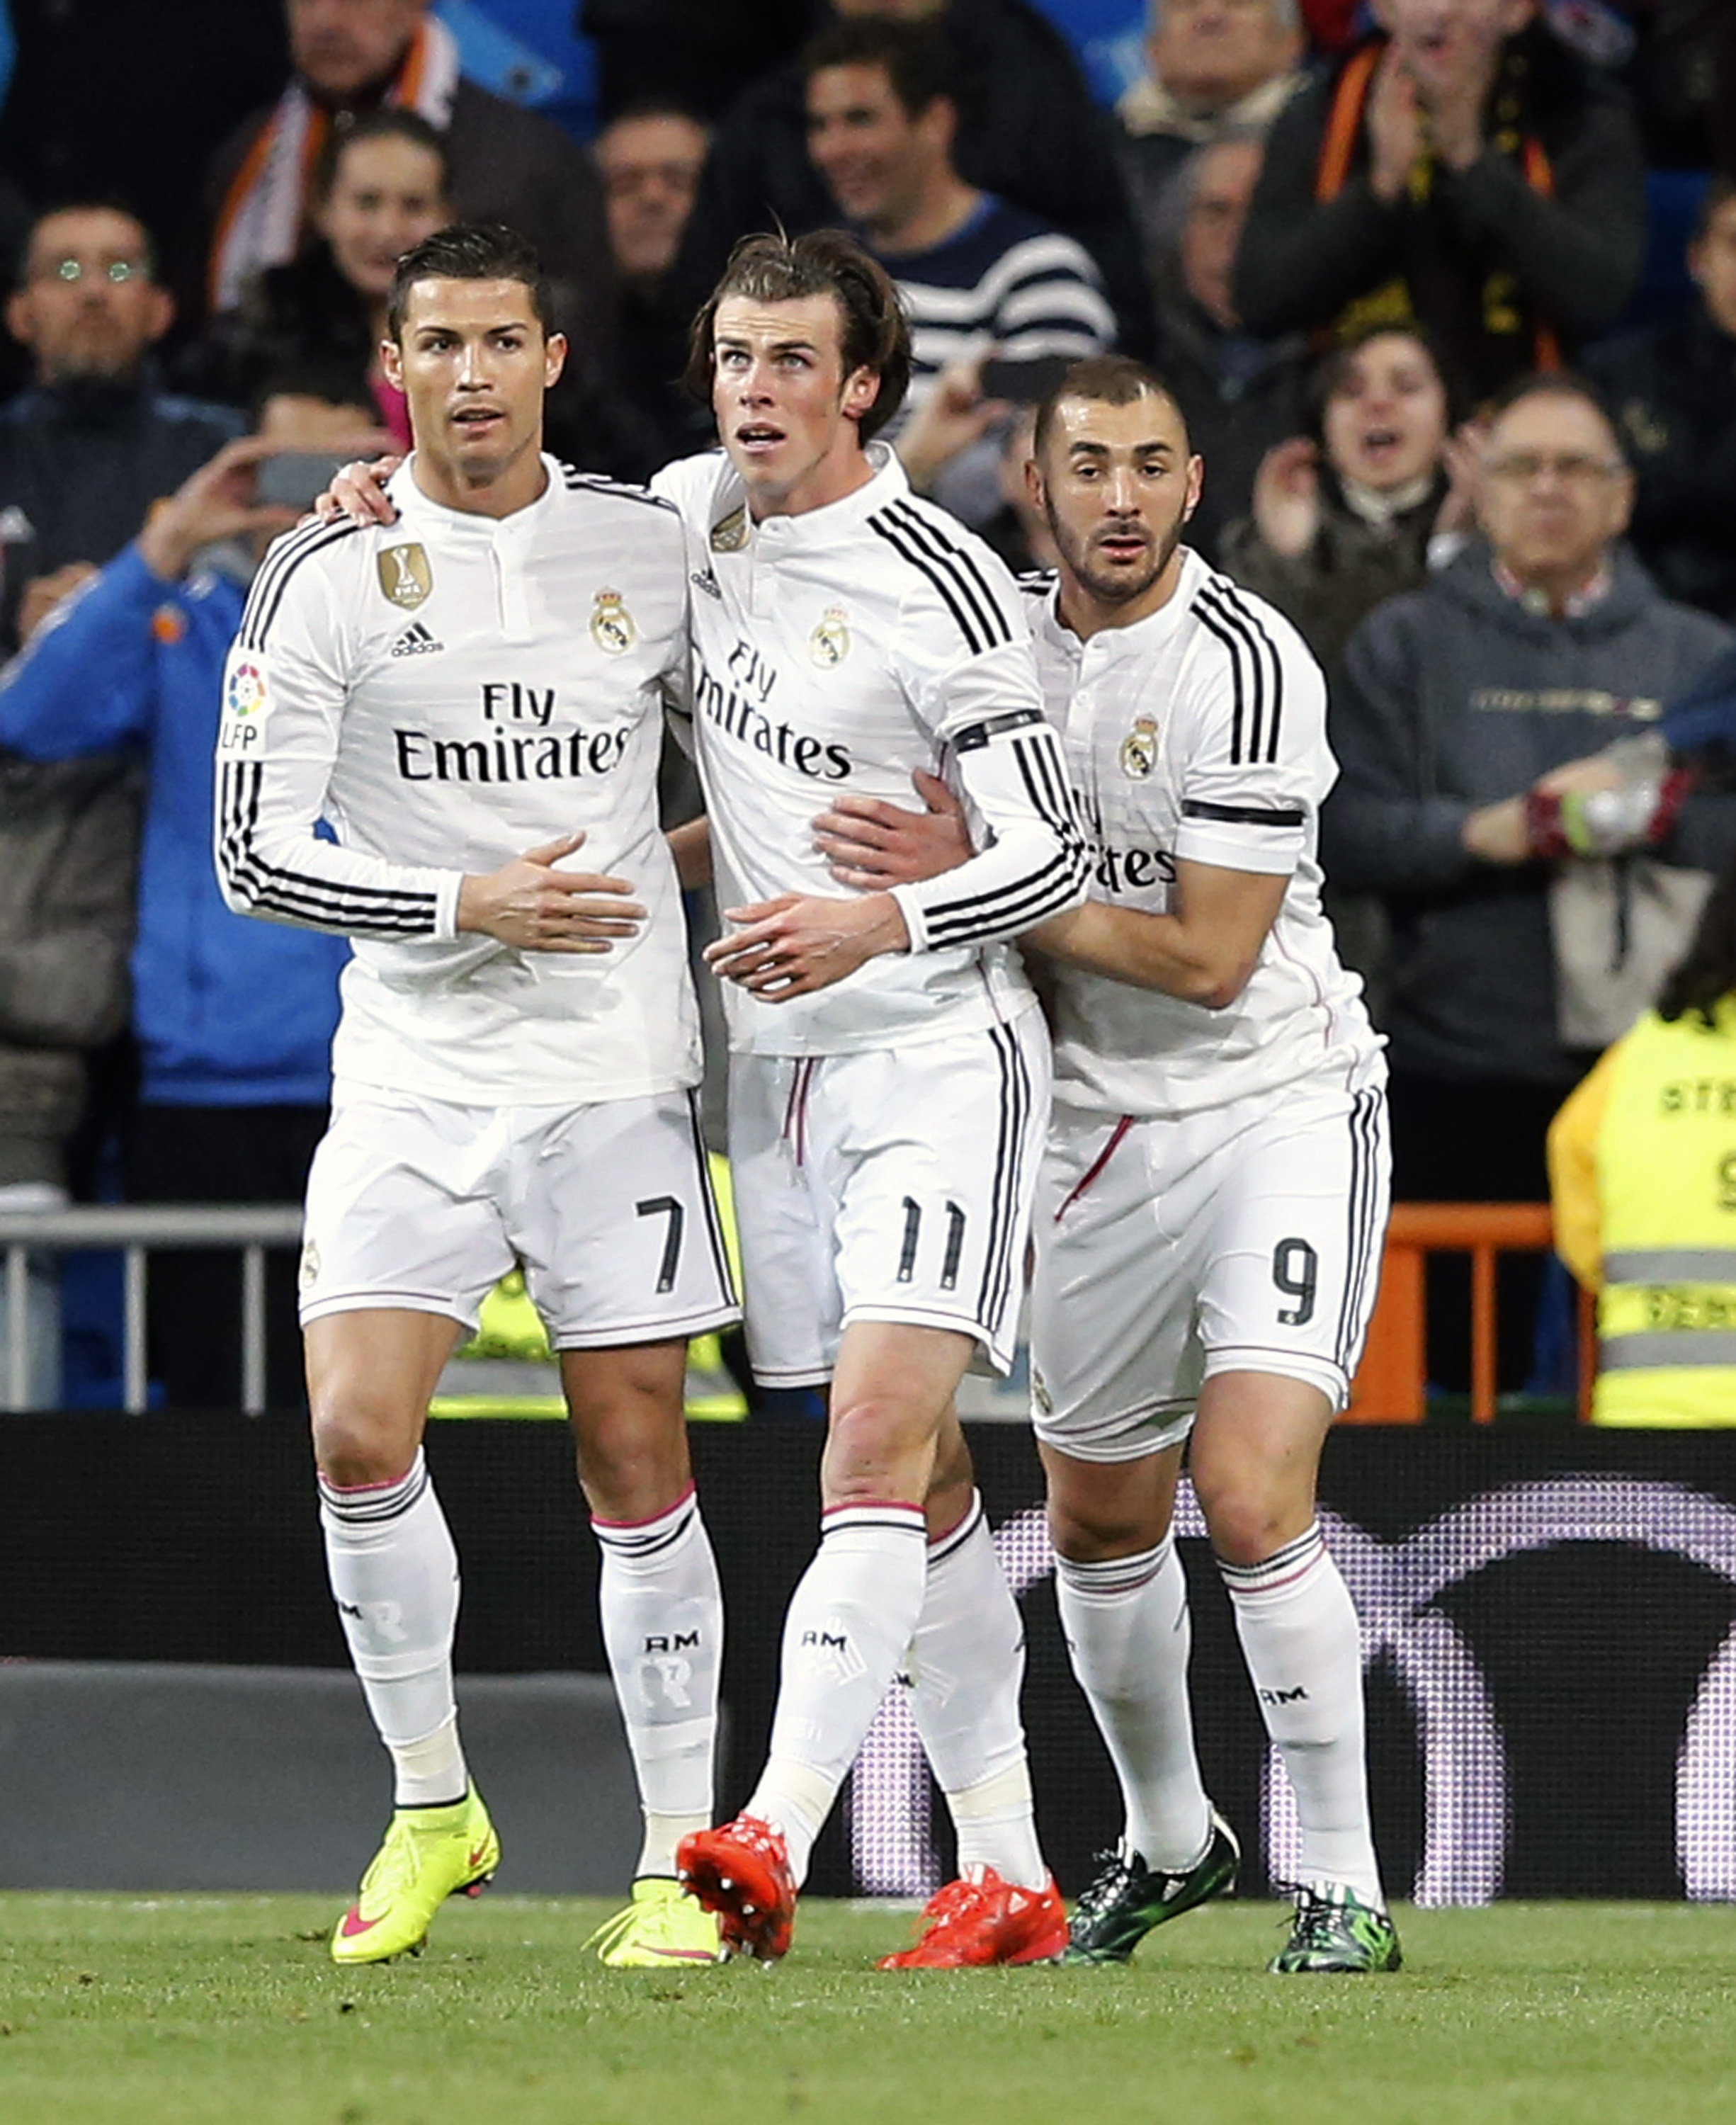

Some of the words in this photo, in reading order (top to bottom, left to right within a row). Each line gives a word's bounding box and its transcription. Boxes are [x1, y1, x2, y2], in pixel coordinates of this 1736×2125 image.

[392, 642, 444, 657] adidas
[727, 639, 777, 702] Fly
[222, 722, 258, 750] LFP
[482, 682, 555, 727] Fly
[691, 640, 852, 780] mirates
[392, 726, 630, 783] Emirates
[635, 1195, 683, 1293] 7
[896, 1195, 967, 1291] 11
[1273, 1237, 1319, 1327] 9
